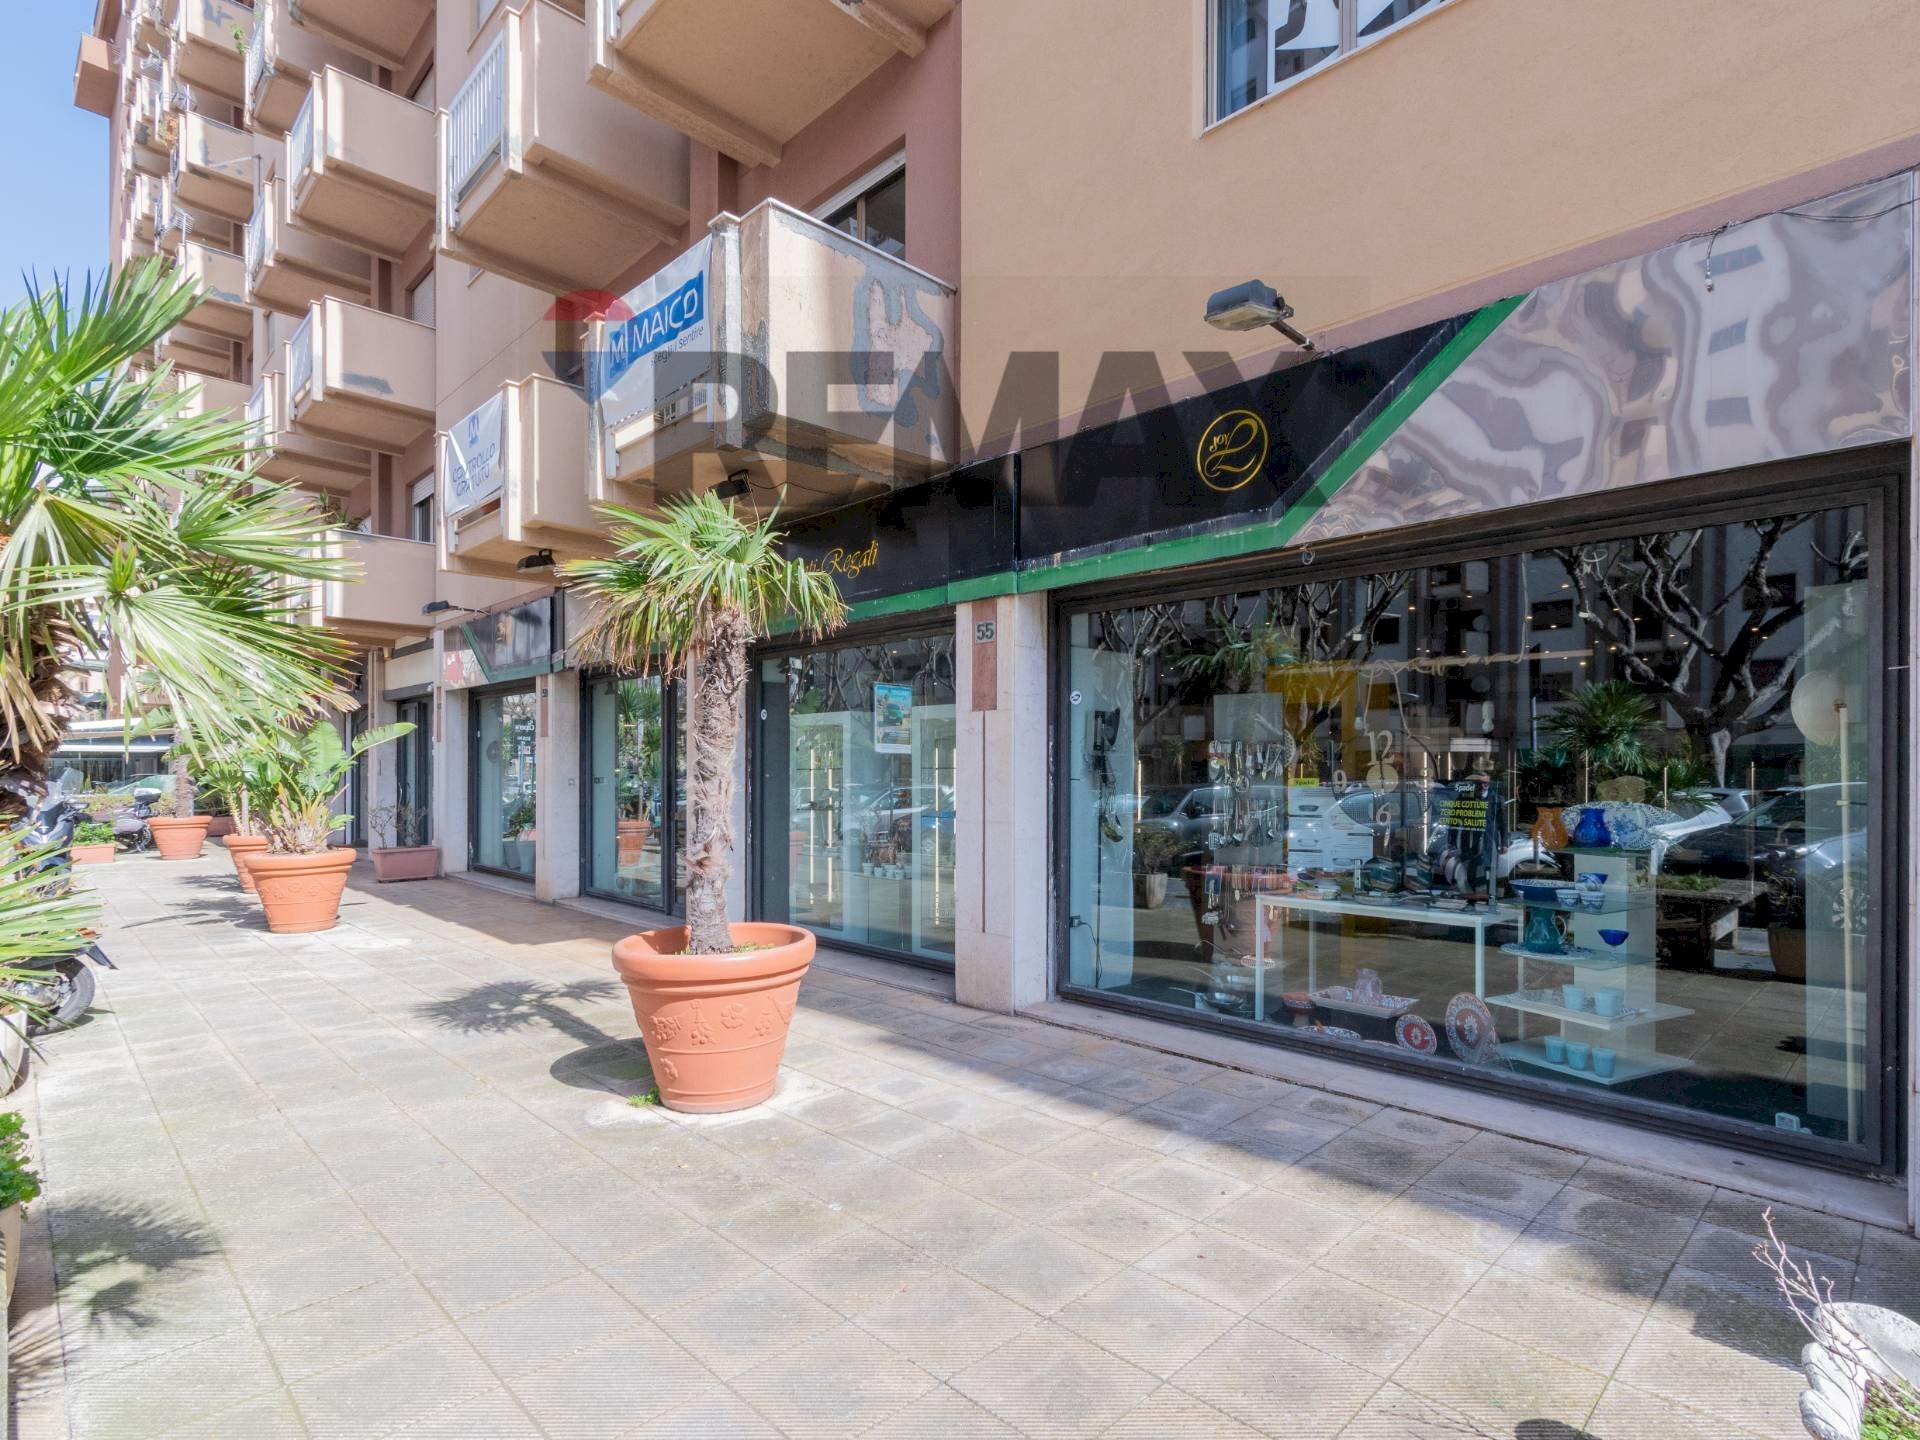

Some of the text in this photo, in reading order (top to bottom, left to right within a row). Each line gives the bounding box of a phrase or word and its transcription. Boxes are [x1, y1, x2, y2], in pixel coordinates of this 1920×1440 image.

[632, 288, 698, 353] MAICO
[453, 442, 496, 483] COTROLLO
[821, 539, 879, 580] Regali
[976, 622, 994, 640] 55
[1368, 730, 1394, 766] 12
